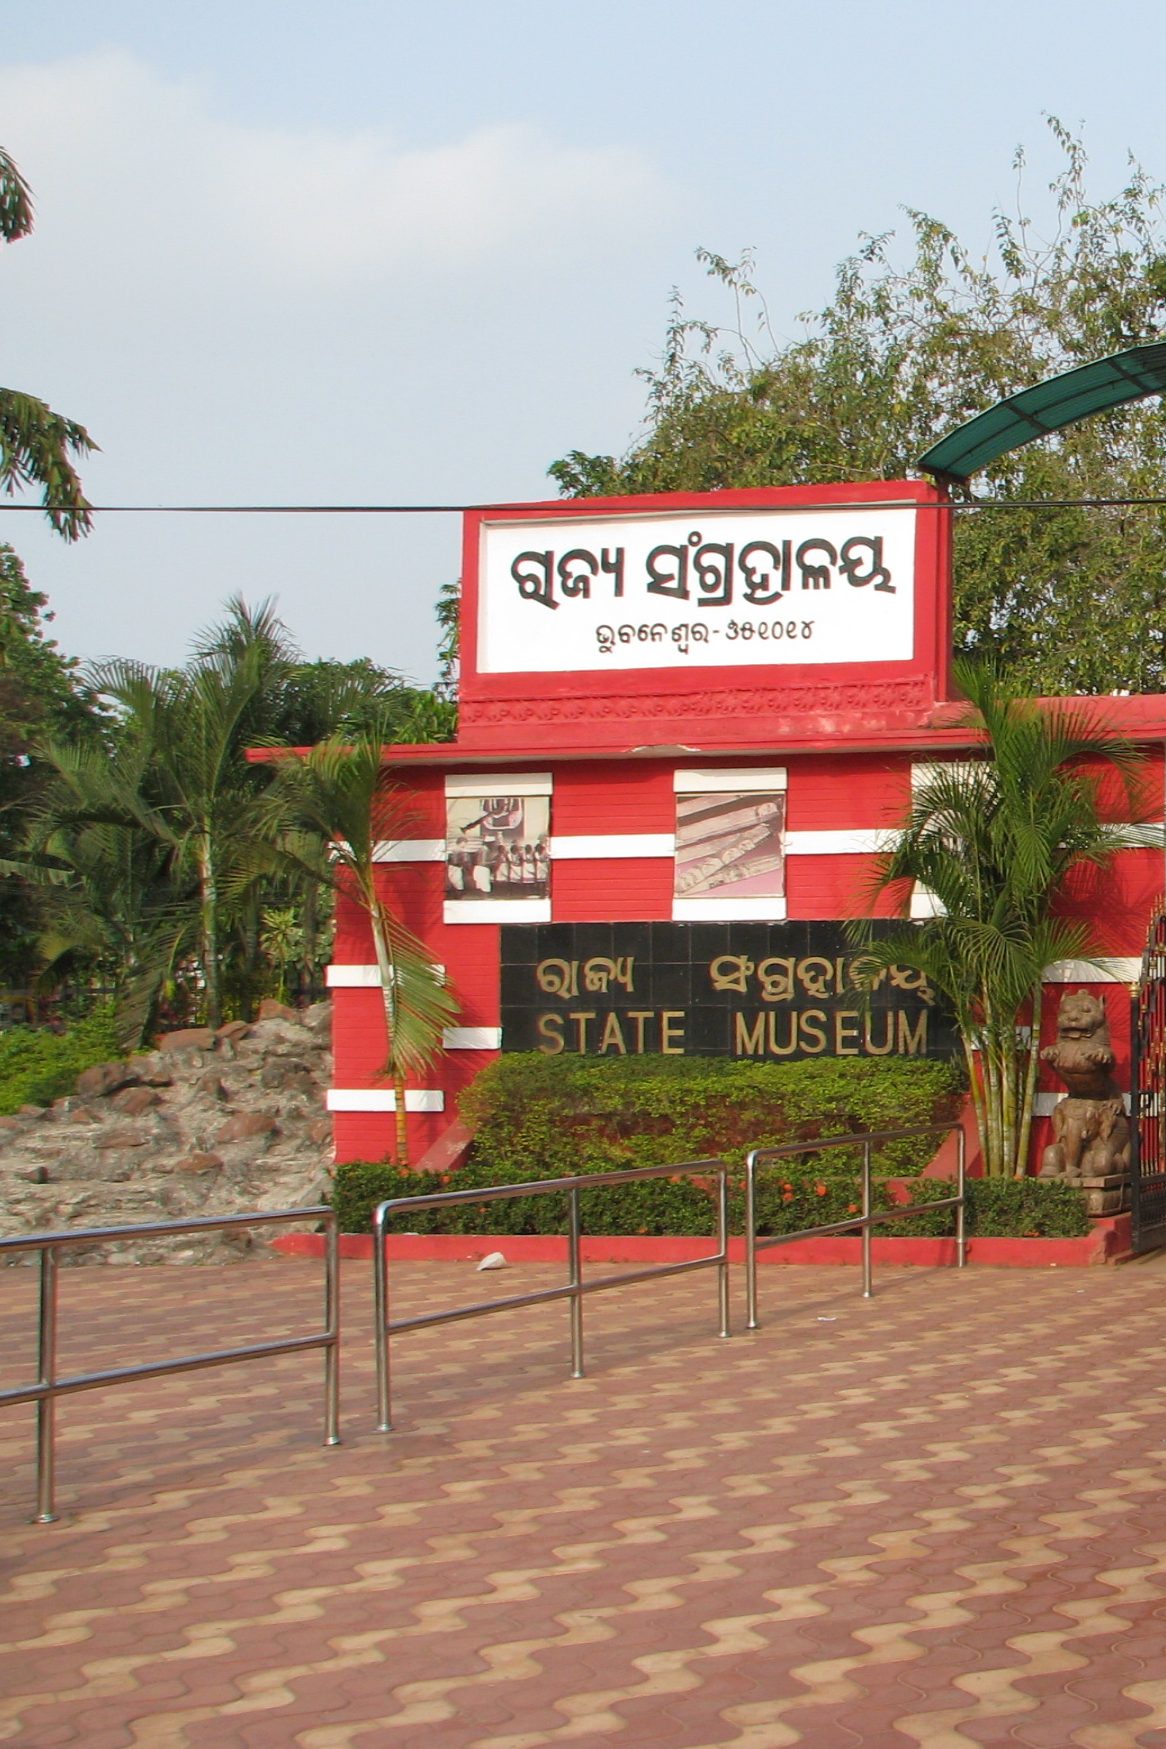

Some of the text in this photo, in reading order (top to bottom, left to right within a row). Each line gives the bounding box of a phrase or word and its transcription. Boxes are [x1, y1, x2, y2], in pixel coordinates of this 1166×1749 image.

[510, 546, 625, 610] ରାଜ୍ୟ
[536, 956, 635, 999] ରାଜ୍ୟ
[539, 1009, 928, 1055] STATE MUSEUM
